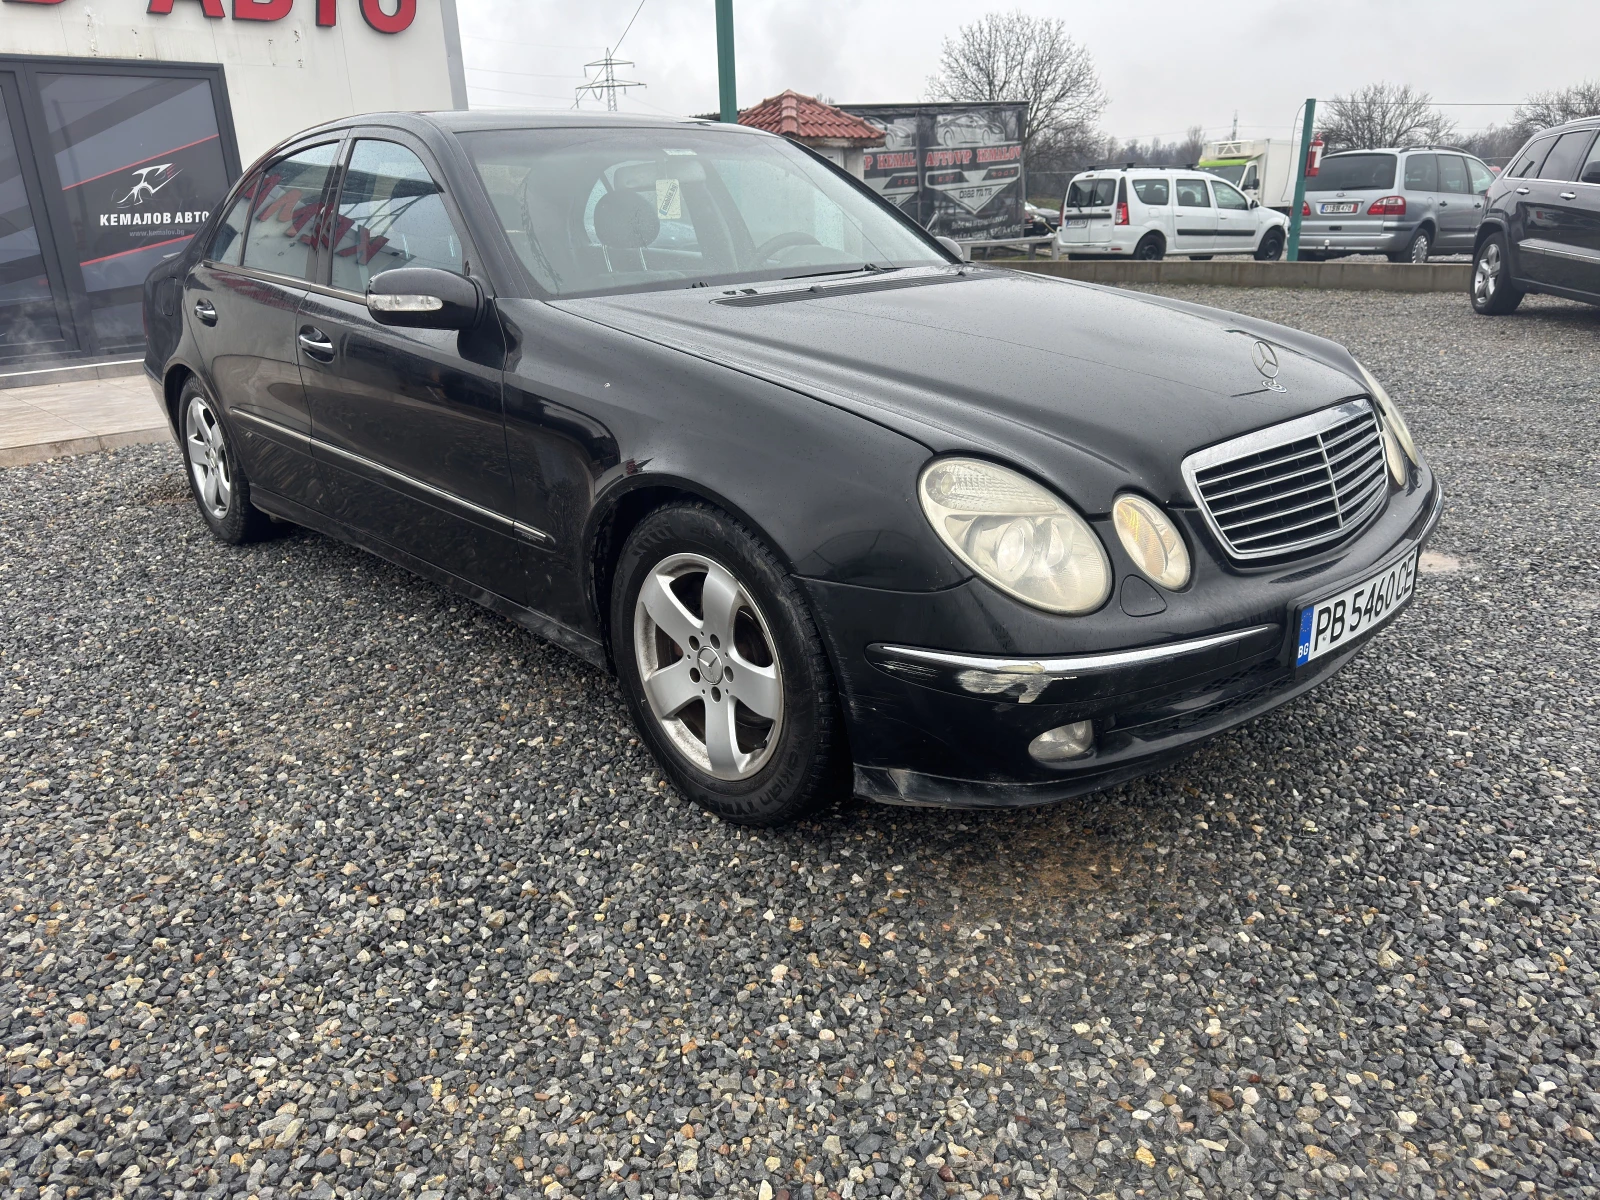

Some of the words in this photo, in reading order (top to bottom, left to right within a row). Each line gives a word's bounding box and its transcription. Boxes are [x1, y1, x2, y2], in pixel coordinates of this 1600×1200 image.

[100, 212, 171, 226] КЕМАЛОВ
[129, 228, 185, 237] www.kemalov.bg
[1313, 599, 1346, 652] PB
[1349, 571, 1396, 632] 5460
[1396, 554, 1415, 601] CE
[1298, 645, 1309, 658] BG
